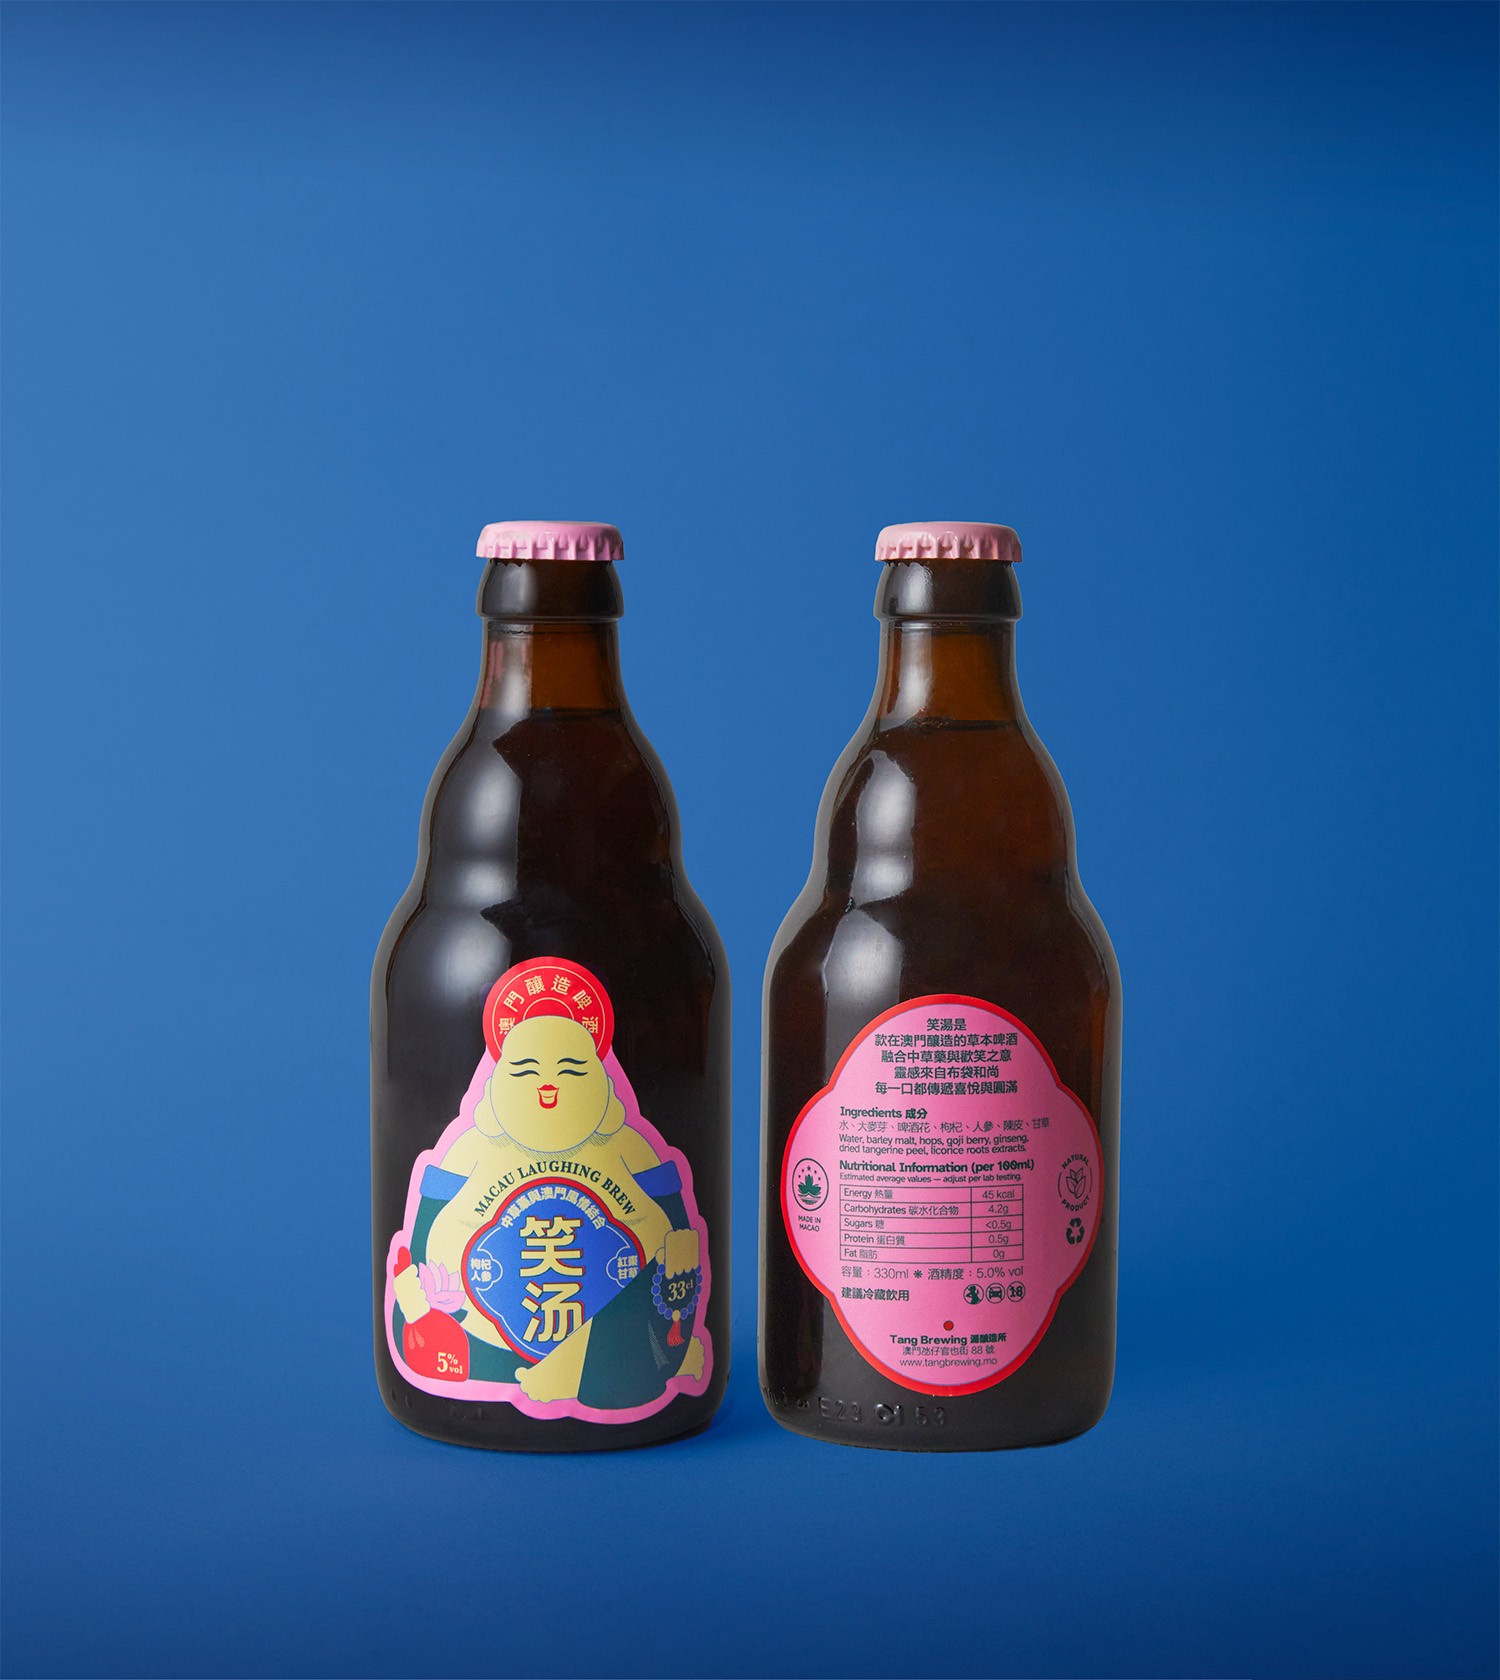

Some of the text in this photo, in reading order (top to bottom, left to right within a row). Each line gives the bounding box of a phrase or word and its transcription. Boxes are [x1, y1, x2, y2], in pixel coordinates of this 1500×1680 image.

[926, 1018, 967, 1031] 笑湯是
[874, 1033, 1018, 1047] 款在澳門釀造的草本啤酒
[894, 1065, 999, 1079] 靈感來自布袋和尚
[840, 1106, 928, 1119] Ingredients 成分
[839, 1134, 865, 1144] Water,
[866, 1135, 893, 1146] barley
[895, 1137, 917, 1146] malt,
[919, 1136, 945, 1147] hops,
[946, 1136, 964, 1147] goji
[966, 1136, 991, 1146] berry,
[839, 1144, 1026, 1156] dried tangerine peel, licorice roots extracts.
[839, 1159, 1034, 1174] Nutritional Information (per 100ml)
[1062, 1154, 1089, 1169] NATURAL
[839, 1173, 874, 1181] Estimated
[876, 1175, 905, 1184] average
[907, 1175, 931, 1183] values
[943, 1175, 966, 1184] adjust
[968, 1175, 981, 1183] per
[996, 1173, 1022, 1182] testing.
[474, 1160, 636, 1217] MACAU LAUGHING BREW
[844, 1188, 872, 1199] Energy
[982, 1189, 1015, 1200] 45 kcal
[1061, 1194, 1089, 1211] PRODUCT
[844, 1204, 959, 1216] Carbohydrates 碳水化合物
[988, 1204, 1009, 1214] 4.2g
[798, 1215, 813, 1223] MADE
[844, 1218, 873, 1229] Sugars
[799, 1224, 820, 1232] MACAO
[985, 1220, 1012, 1230] <0.5g
[844, 1233, 874, 1243] Protein
[988, 1234, 1009, 1244] 0.5g
[844, 1249, 857, 1257] Fat
[992, 1249, 1005, 1259] 0g
[1008, 1265, 1024, 1276] vol
[520, 1216, 585, 1343] 笑汤
[668, 1279, 694, 1302] 33cl
[841, 1287, 909, 1301] 建議冷藏飲用
[890, 1335, 918, 1346] Tang
[920, 1335, 968, 1346] Brewing
[971, 1346, 983, 1355] 88
[437, 1352, 459, 1373] 5%
[900, 1357, 997, 1368] www.tangbrewing.mo
[449, 1366, 463, 1374] vol
